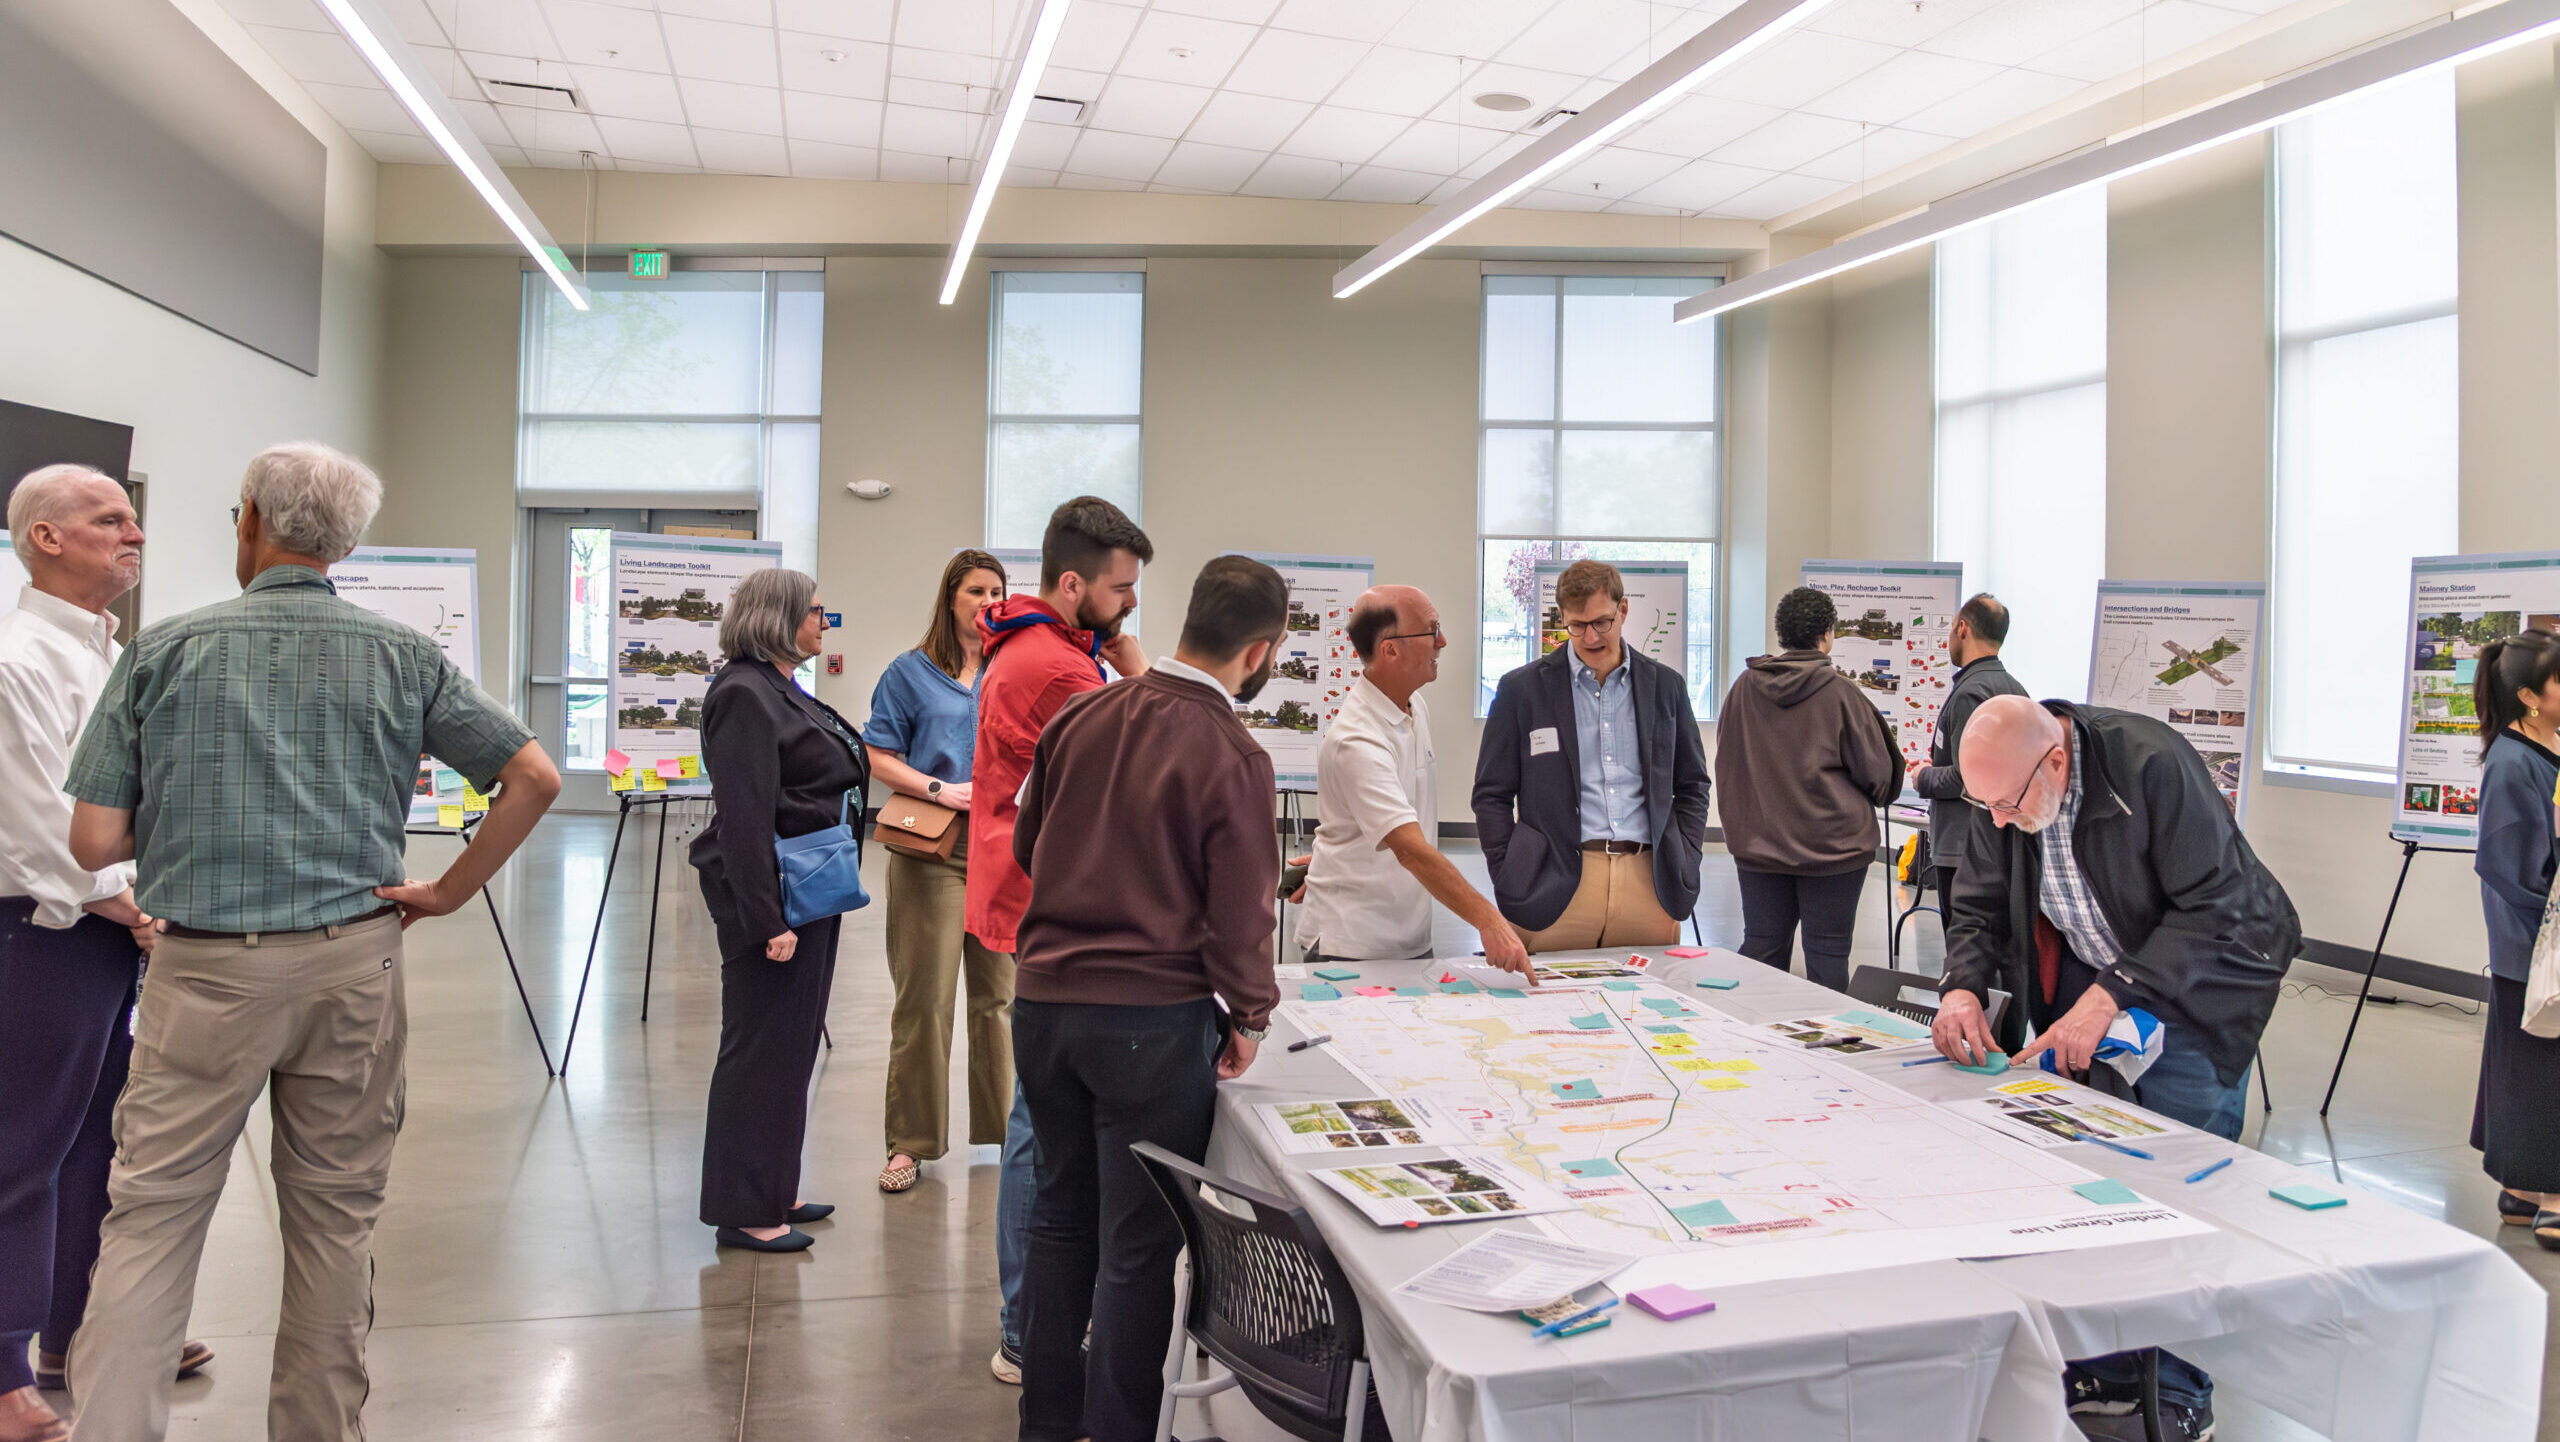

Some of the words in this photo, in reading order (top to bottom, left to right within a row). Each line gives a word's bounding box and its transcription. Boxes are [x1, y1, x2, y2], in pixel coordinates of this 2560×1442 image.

[634, 252, 663, 276] EXIT
[620, 558, 642, 568] Living
[643, 560, 686, 570] Landscapes
[688, 562, 711, 570] Toolkit
[1830, 584, 1845, 592] Play,
[1847, 584, 1879, 593] Recharge
[1880, 585, 1902, 593] Toolkit
[2418, 585, 2449, 594] Maloney
[2449, 583, 2476, 593] Station
[2104, 604, 2149, 613] Intersections
[2163, 606, 2191, 614] Bridges
[2058, 1218, 2113, 1230] Green
[2114, 1212, 2179, 1224] Linden
[2009, 1223, 2055, 1236] Line
